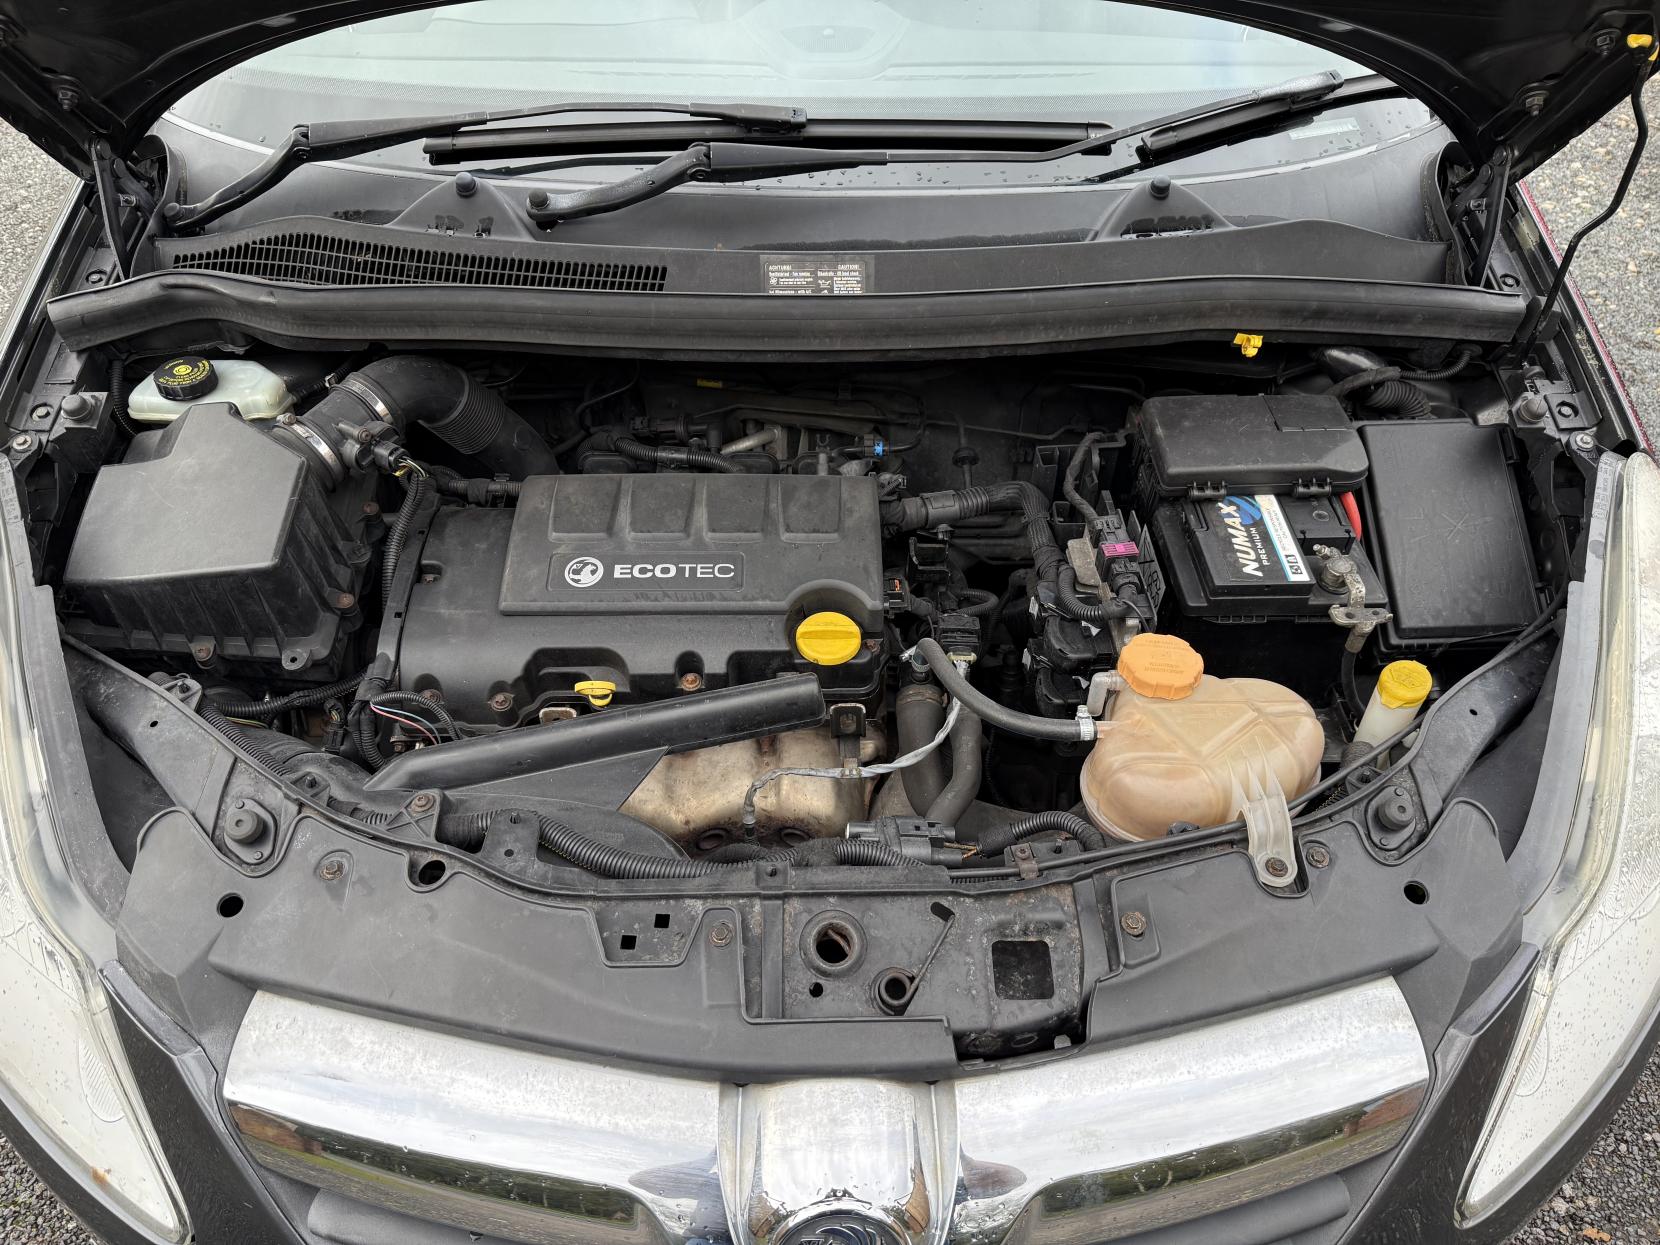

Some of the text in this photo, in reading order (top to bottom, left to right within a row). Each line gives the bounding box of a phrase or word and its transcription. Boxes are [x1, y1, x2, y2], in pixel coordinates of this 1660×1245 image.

[1216, 502, 1264, 577] NUMAX
[1249, 527, 1271, 566] PREMIUM
[613, 563, 736, 578] ECOTEC
